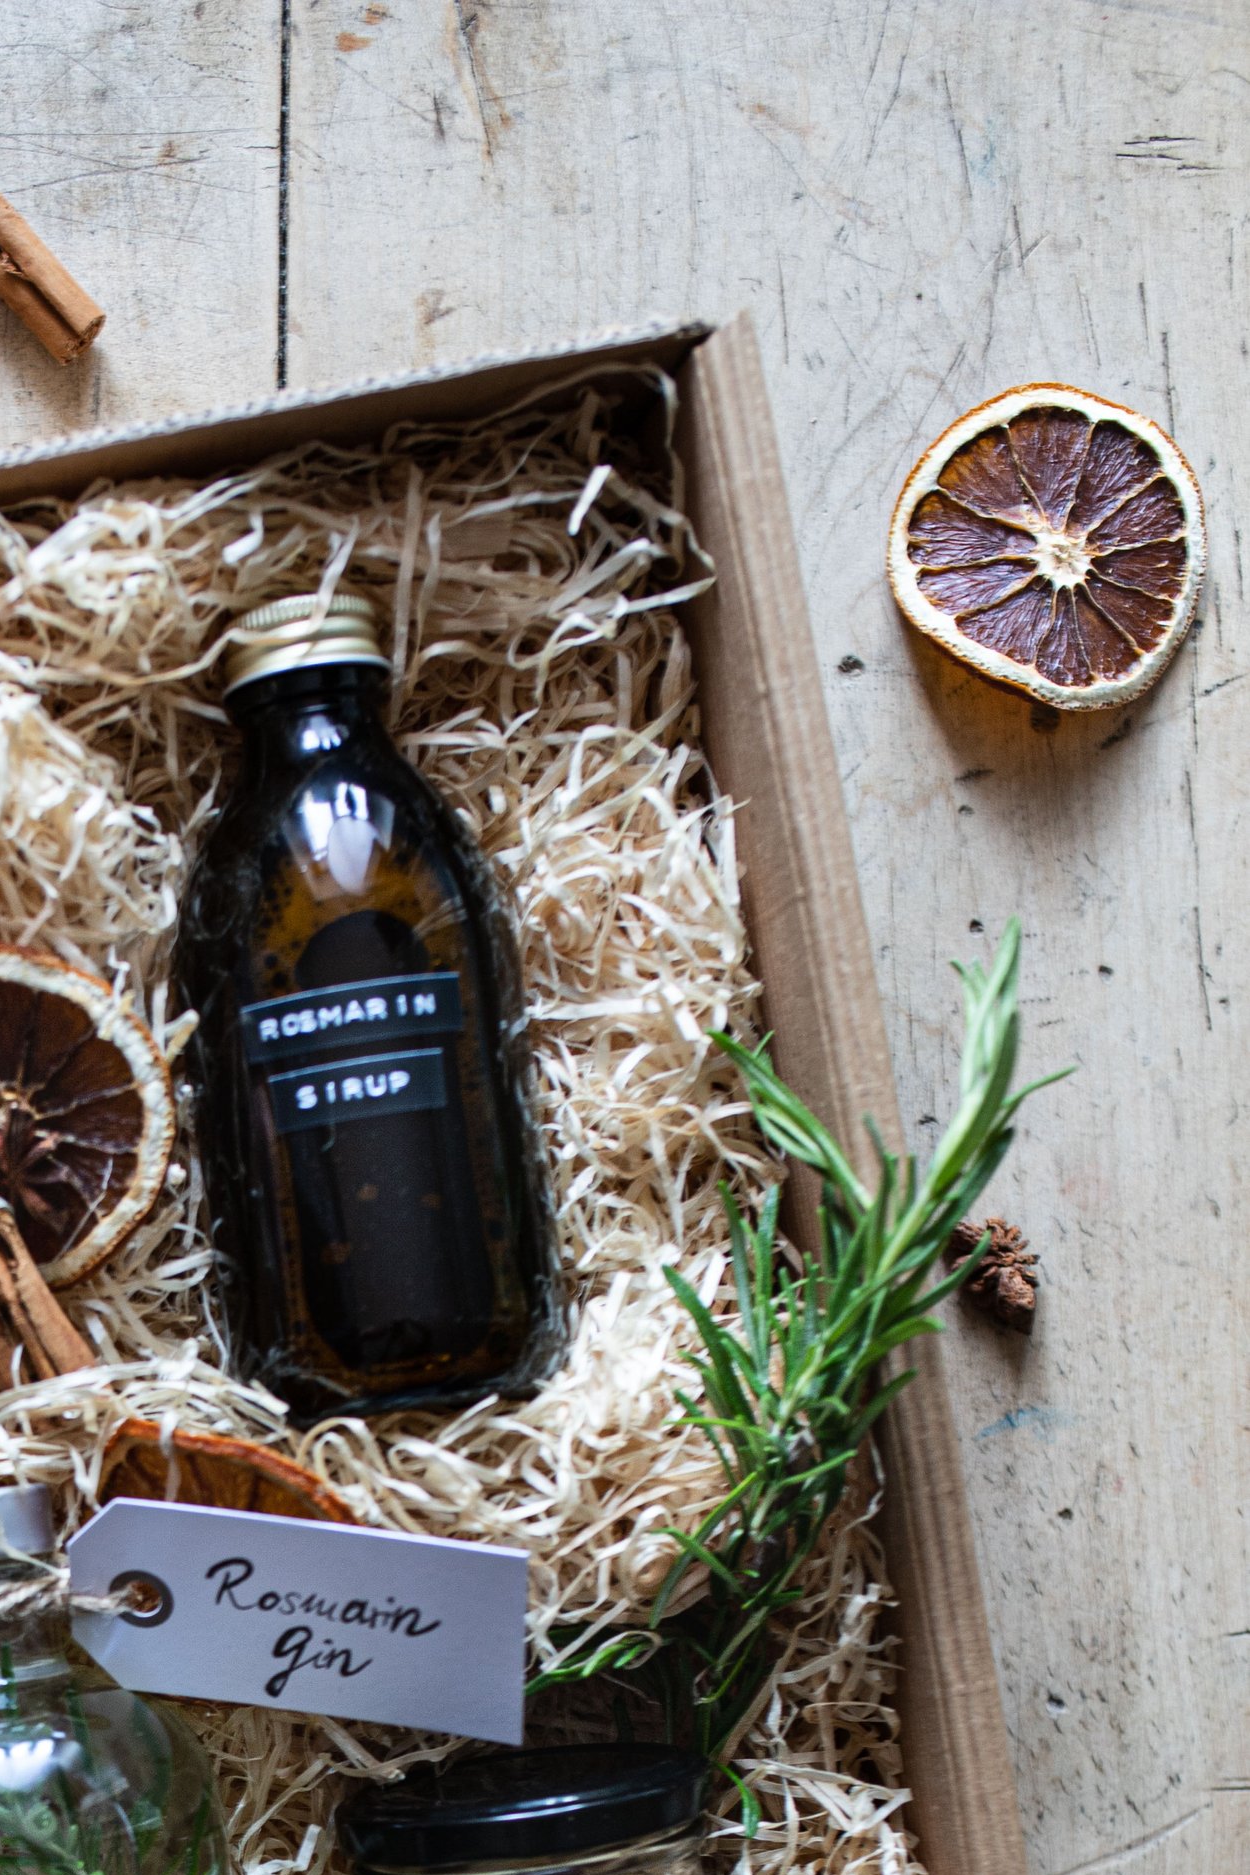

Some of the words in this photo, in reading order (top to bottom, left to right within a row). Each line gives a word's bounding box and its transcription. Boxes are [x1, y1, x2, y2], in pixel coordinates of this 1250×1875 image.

[259, 993, 436, 1042] ROSMARIN
[296, 1071, 410, 1109] SIRUP
[205, 1557, 441, 1636] Rosmarin
